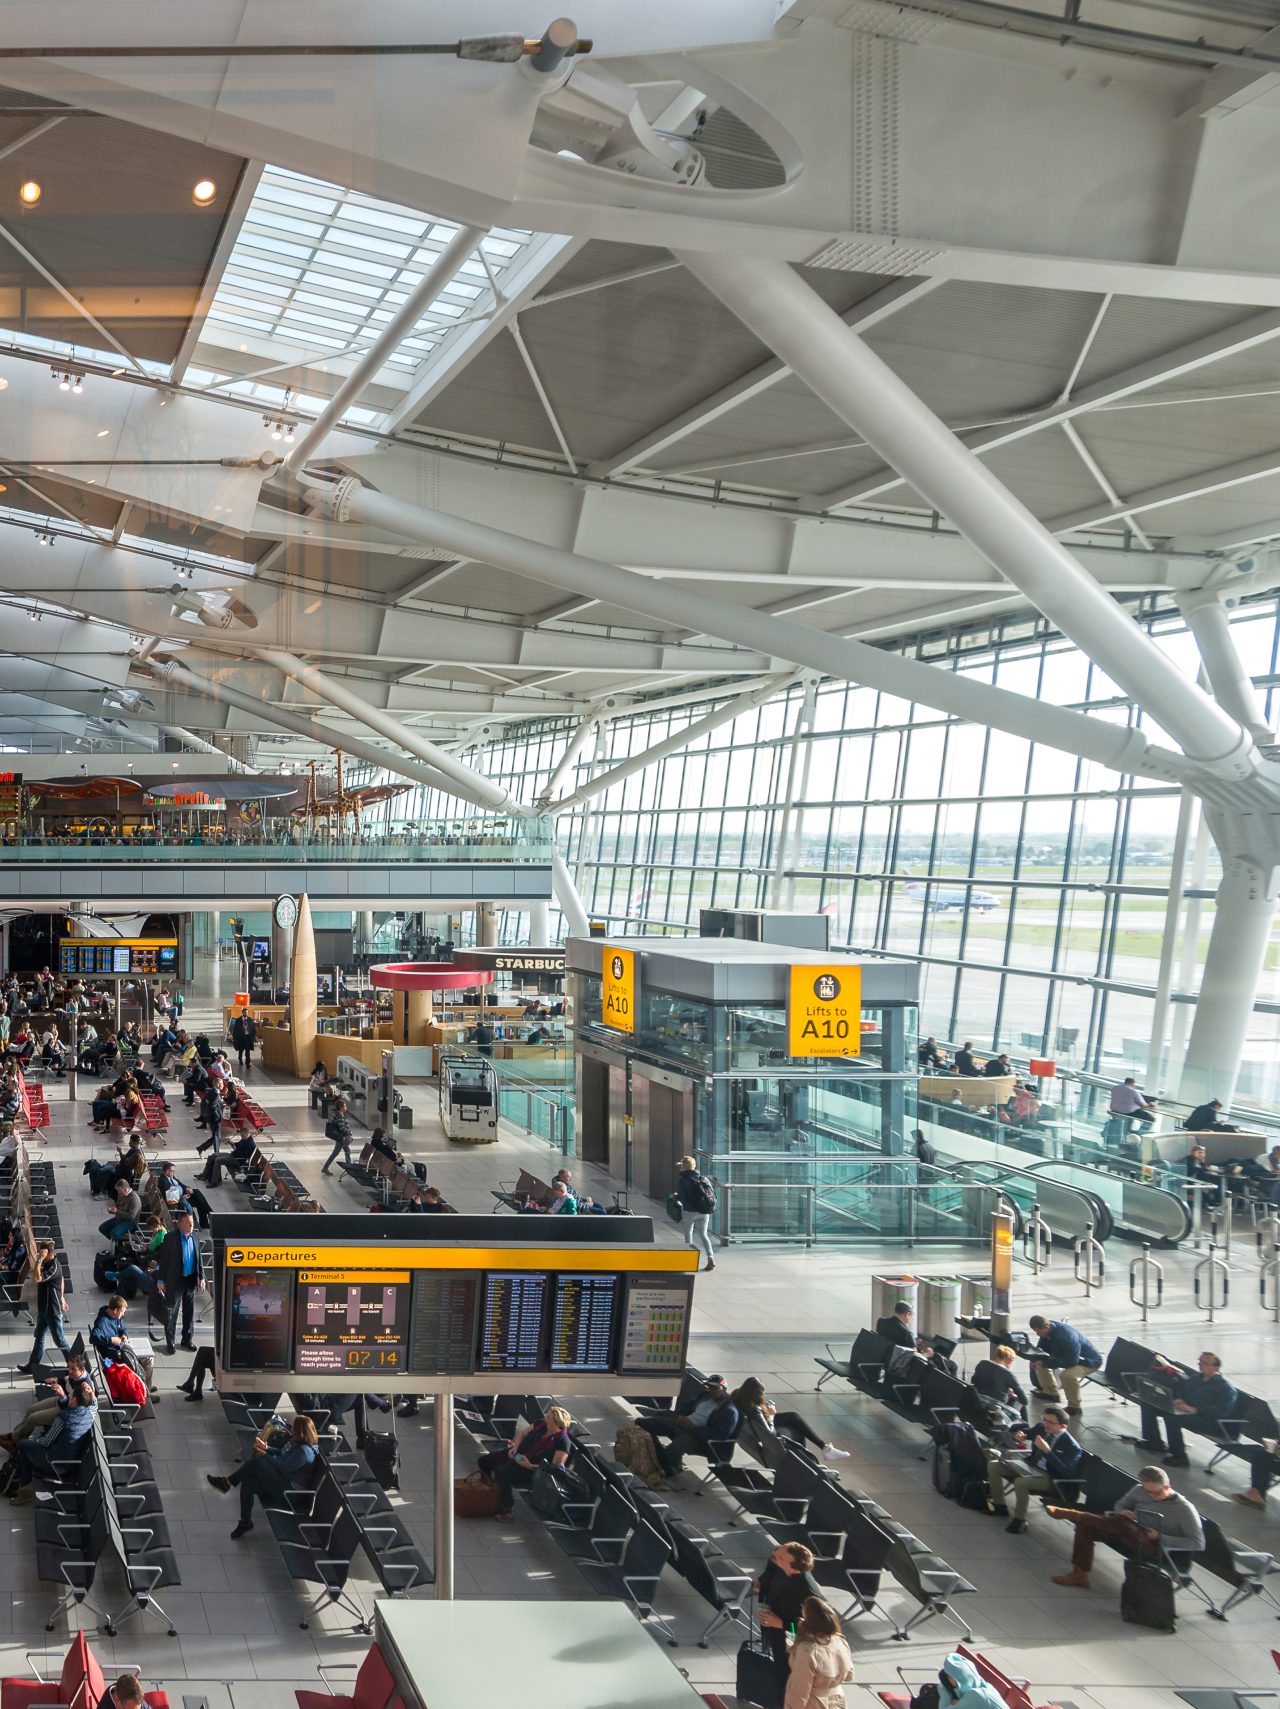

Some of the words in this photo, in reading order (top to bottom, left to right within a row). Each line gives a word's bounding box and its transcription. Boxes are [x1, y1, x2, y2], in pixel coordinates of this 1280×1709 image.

[495, 958, 565, 970] STARBUC
[608, 982, 620, 993] Lifts
[621, 987, 628, 995] to
[606, 993, 629, 1014] A10
[806, 1006, 831, 1016] Lifts
[835, 1007, 847, 1016] to
[801, 1019, 849, 1039] A10
[247, 1251, 317, 1263] Departures
[348, 1351, 371, 1365] 07
[380, 1351, 397, 1365] 14
